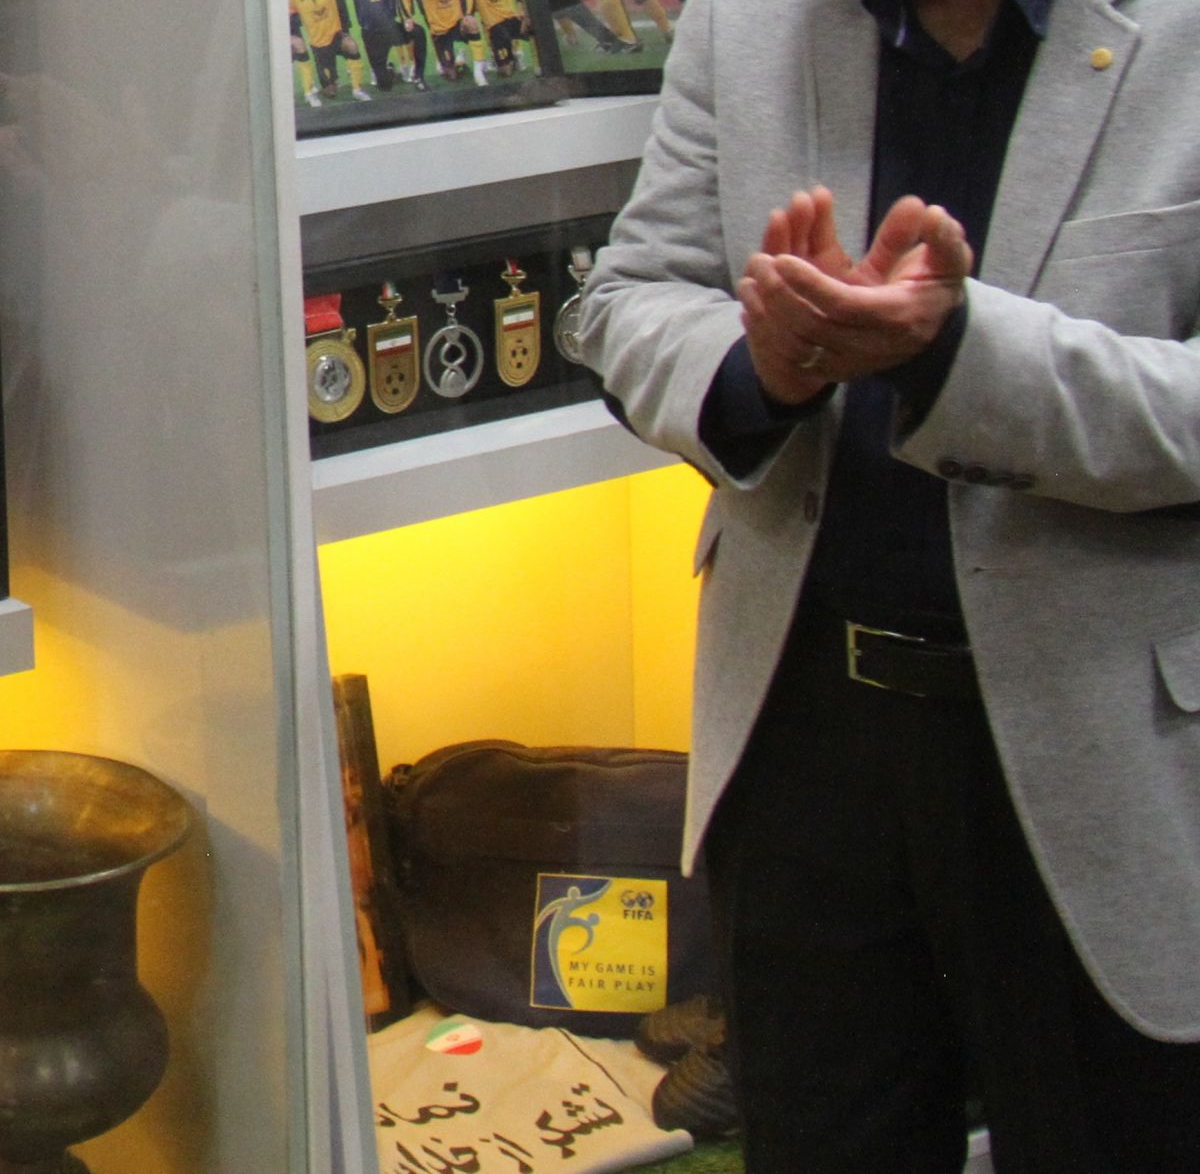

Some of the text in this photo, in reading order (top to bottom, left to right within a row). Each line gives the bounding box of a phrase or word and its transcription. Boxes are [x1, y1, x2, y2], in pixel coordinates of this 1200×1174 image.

[623, 909, 654, 922] FIFA
[569, 961, 655, 977] MY GAME IS
[568, 977, 656, 993] FAIR PLAY
